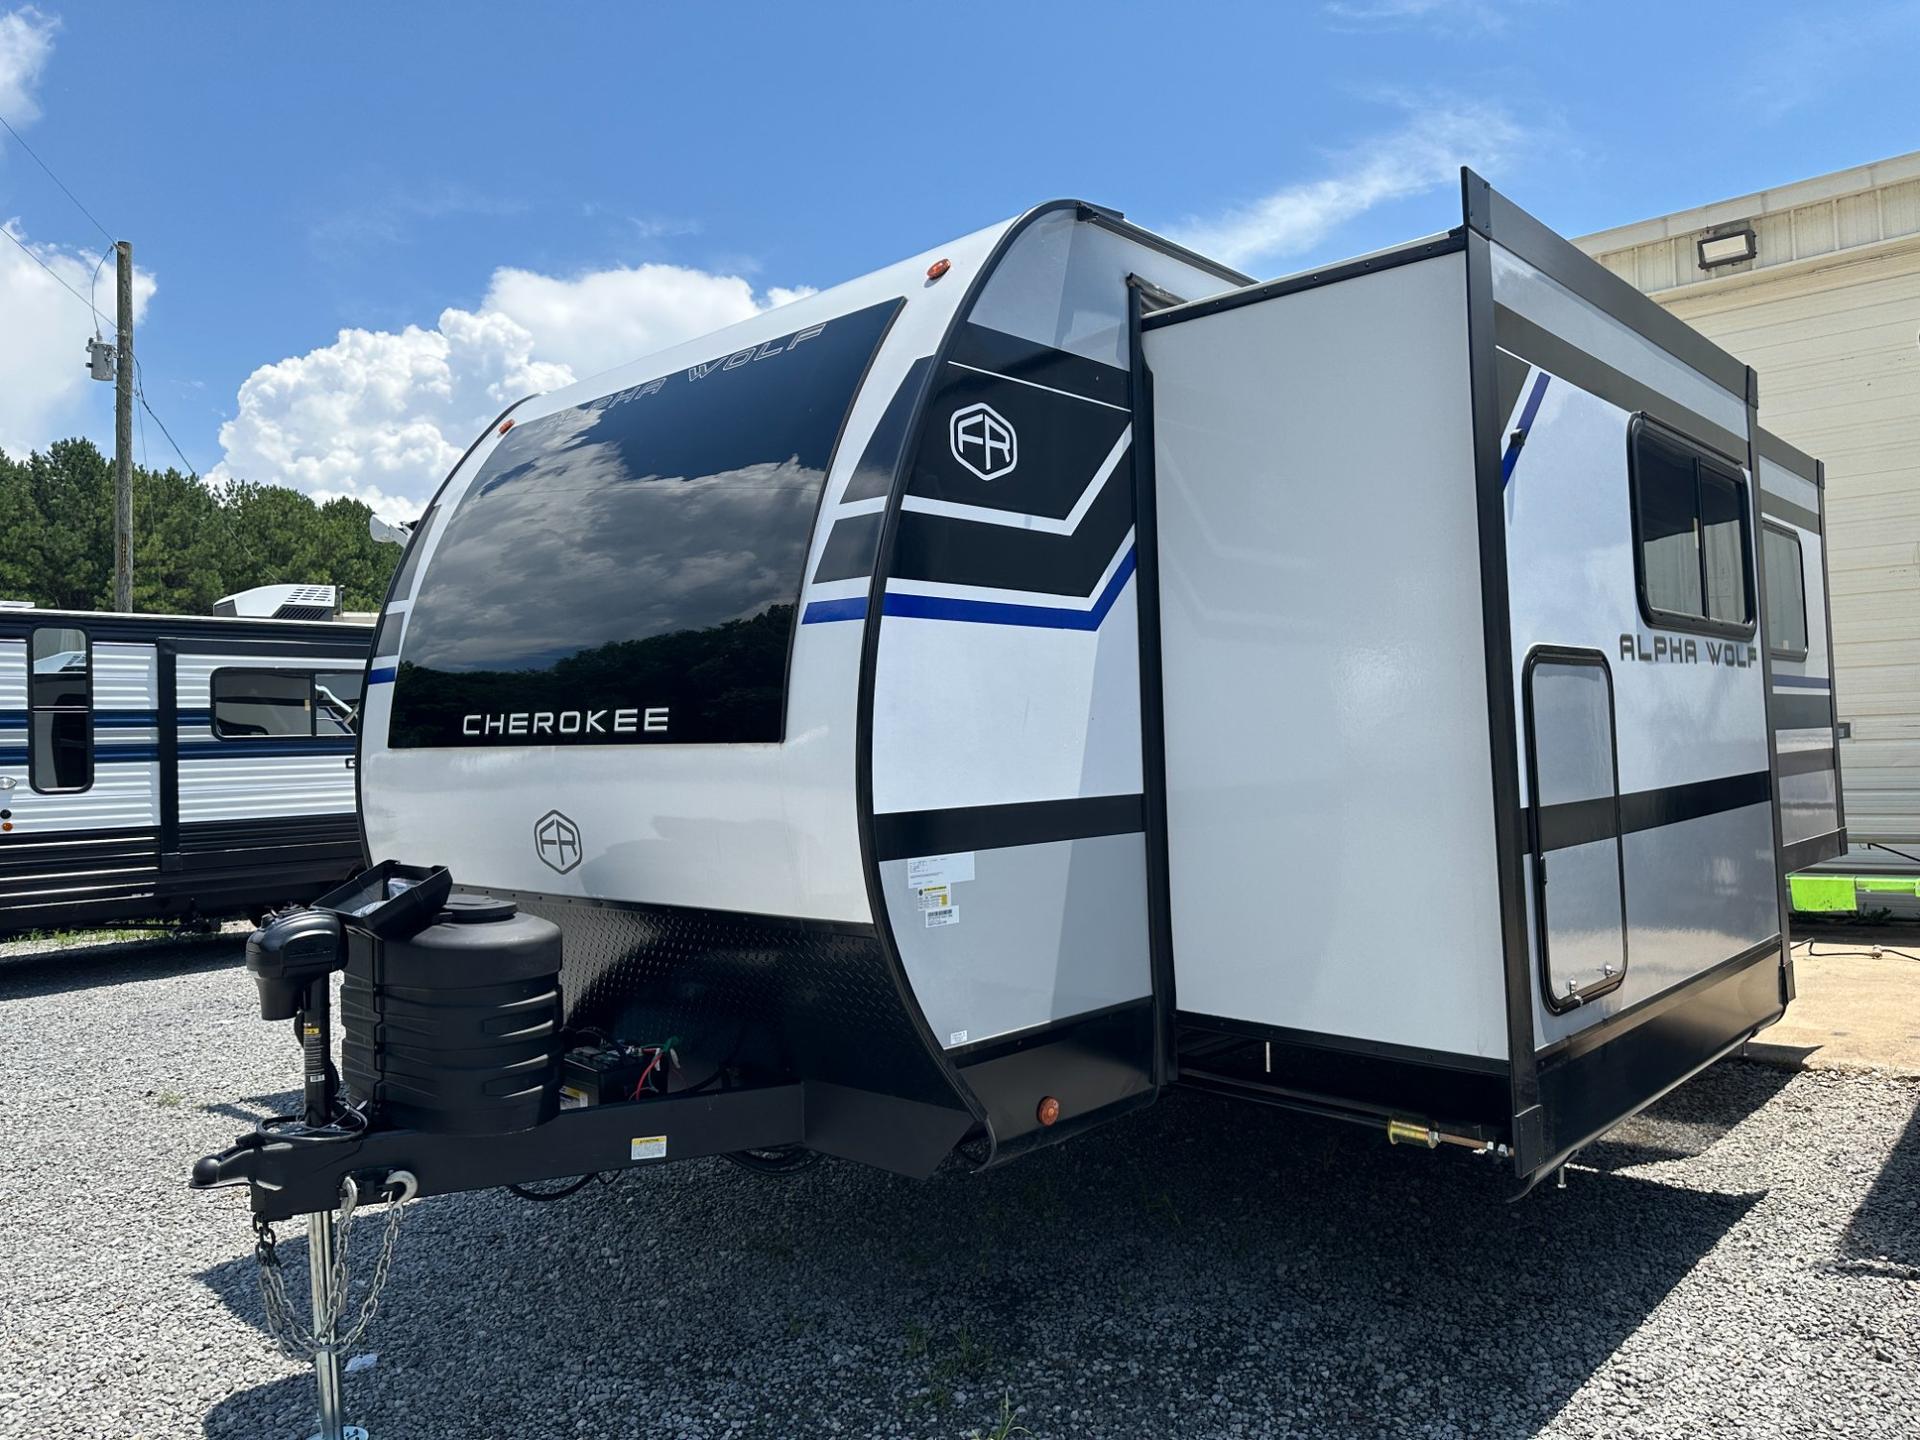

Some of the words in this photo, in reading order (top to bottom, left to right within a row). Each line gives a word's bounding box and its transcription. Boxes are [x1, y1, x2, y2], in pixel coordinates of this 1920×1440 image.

[688, 323, 827, 382] WOLF
[1619, 633, 1698, 665] ALPHA
[1705, 640, 1757, 669] WOLF
[463, 707, 670, 735] CHEROKEE
